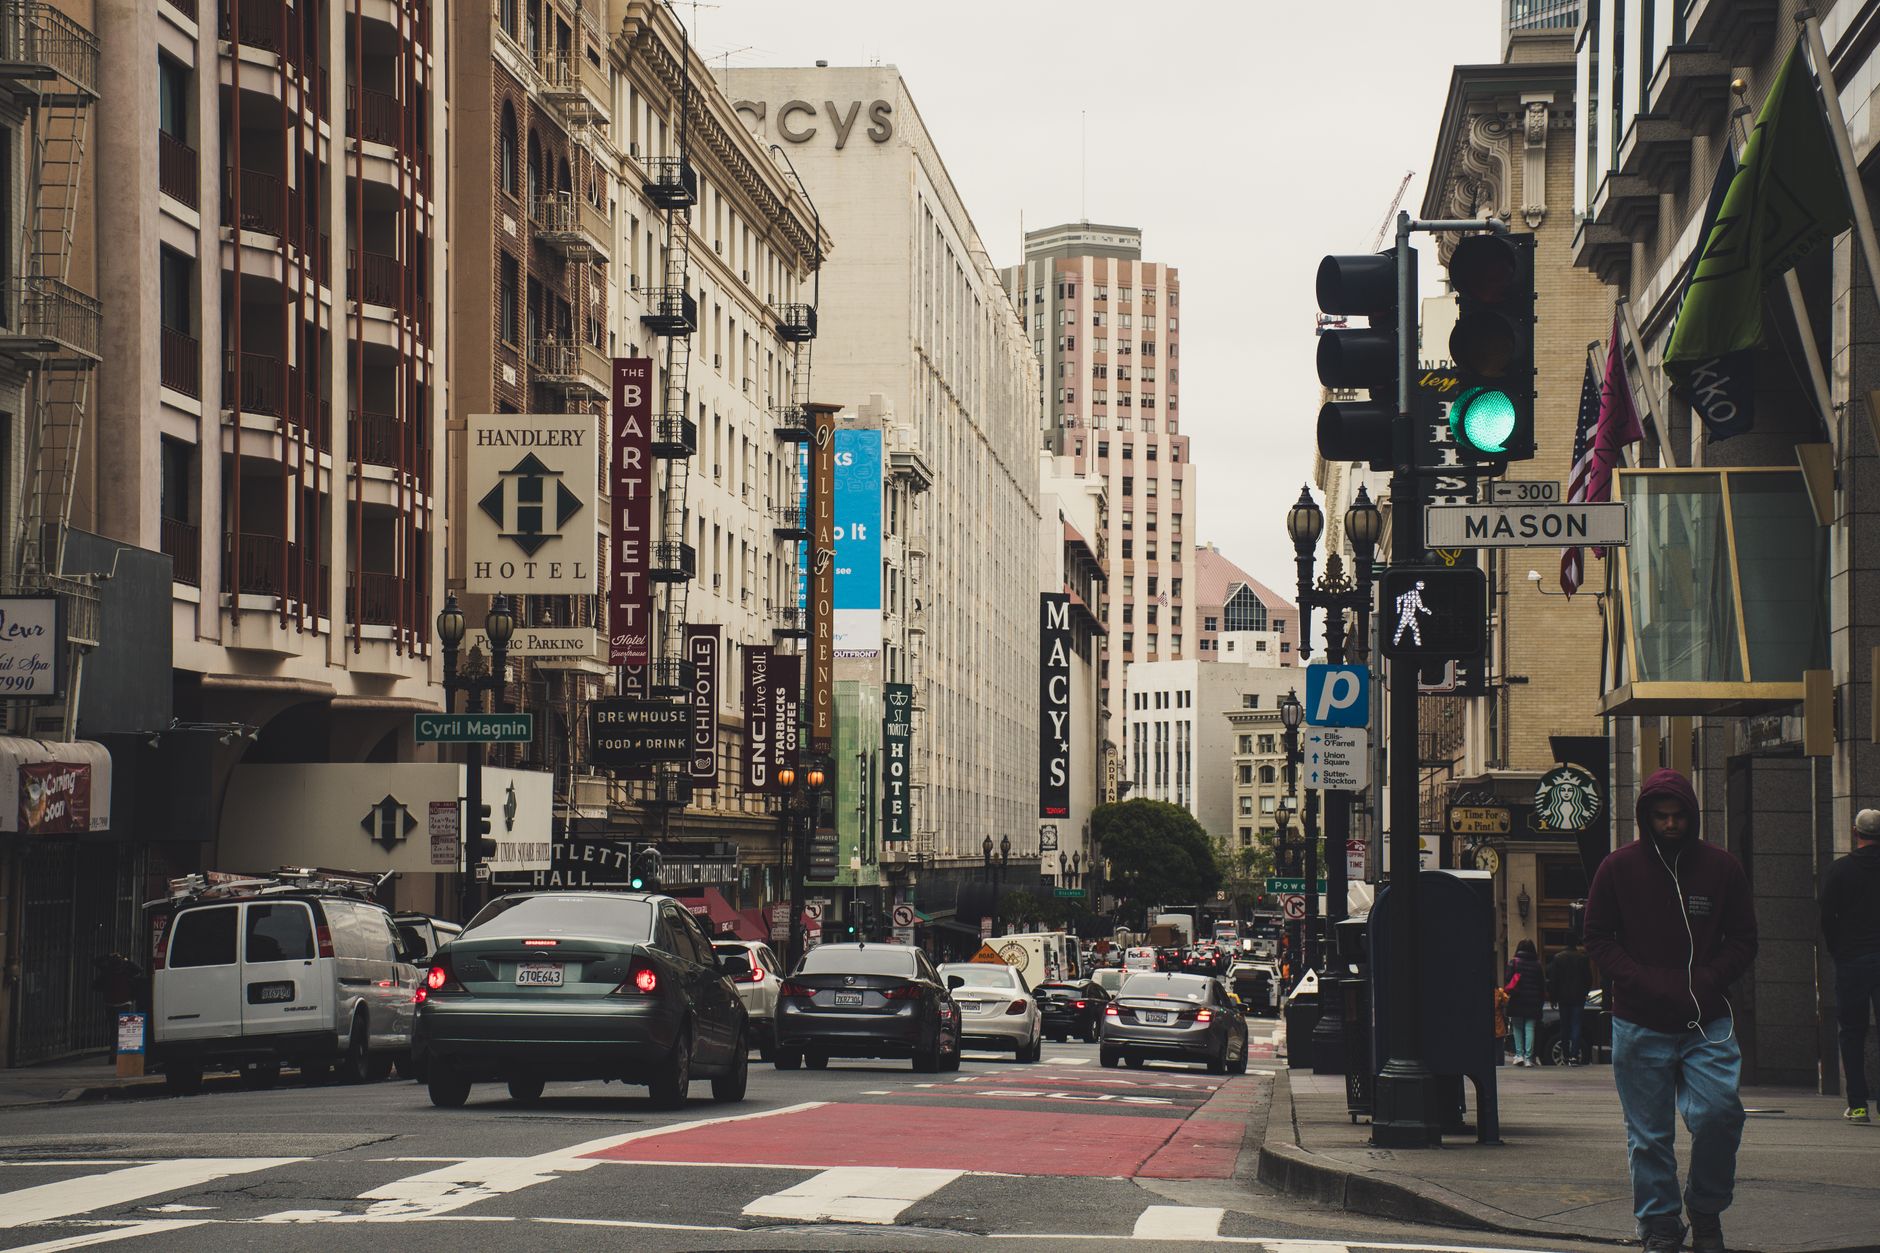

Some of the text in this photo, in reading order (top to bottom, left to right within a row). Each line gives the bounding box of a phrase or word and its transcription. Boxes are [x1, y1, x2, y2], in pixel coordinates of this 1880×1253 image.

[732, 99, 892, 150] acys
[621, 368, 645, 378] THE
[1418, 372, 1460, 392] ley
[1691, 358, 1737, 422] KKO
[476, 429, 586, 447] HANDLERY
[817, 424, 837, 543] VILLA
[1517, 484, 1553, 500] 300
[619, 384, 645, 626] BARTLETT
[1465, 513, 1587, 539] MASON
[474, 562, 587, 579] HOTEL
[474, 634, 584, 650] PUIC PARKING
[611, 634, 647, 647] Hotel
[815, 547, 837, 728] FLORENCE
[19, 653, 50, 675] Spa
[696, 643, 711, 745] CHIPOTLE
[597, 711, 687, 723] BREWHOUSE
[420, 721, 527, 739] Cyril Magnin
[775, 687, 786, 765] STARBUCKS
[786, 702, 797, 751] COFFEE
[887, 723, 909, 736] MORITZ
[597, 739, 631, 749] FOOD
[646, 738, 686, 749] DRINK
[1324, 732, 1342, 740] Ellis-
[1324, 739, 1355, 747] O'Farrell
[752, 721, 766, 787] GNC
[1323, 751, 1346, 759] Union
[46, 769, 76, 796] Coming
[1323, 770, 1348, 778] Sutter-
[1323, 777, 1357, 785] Stockton
[890, 743, 904, 833] HOTEL
[1463, 809, 1499, 819] Time For
[552, 842, 627, 869] TLETT
[1349, 860, 1363, 868] TIME
[533, 870, 591, 887] HALL
[1274, 881, 1306, 890] Powe
[1127, 951, 1151, 959] FedEx
[519, 970, 561, 983] 6TQE643
